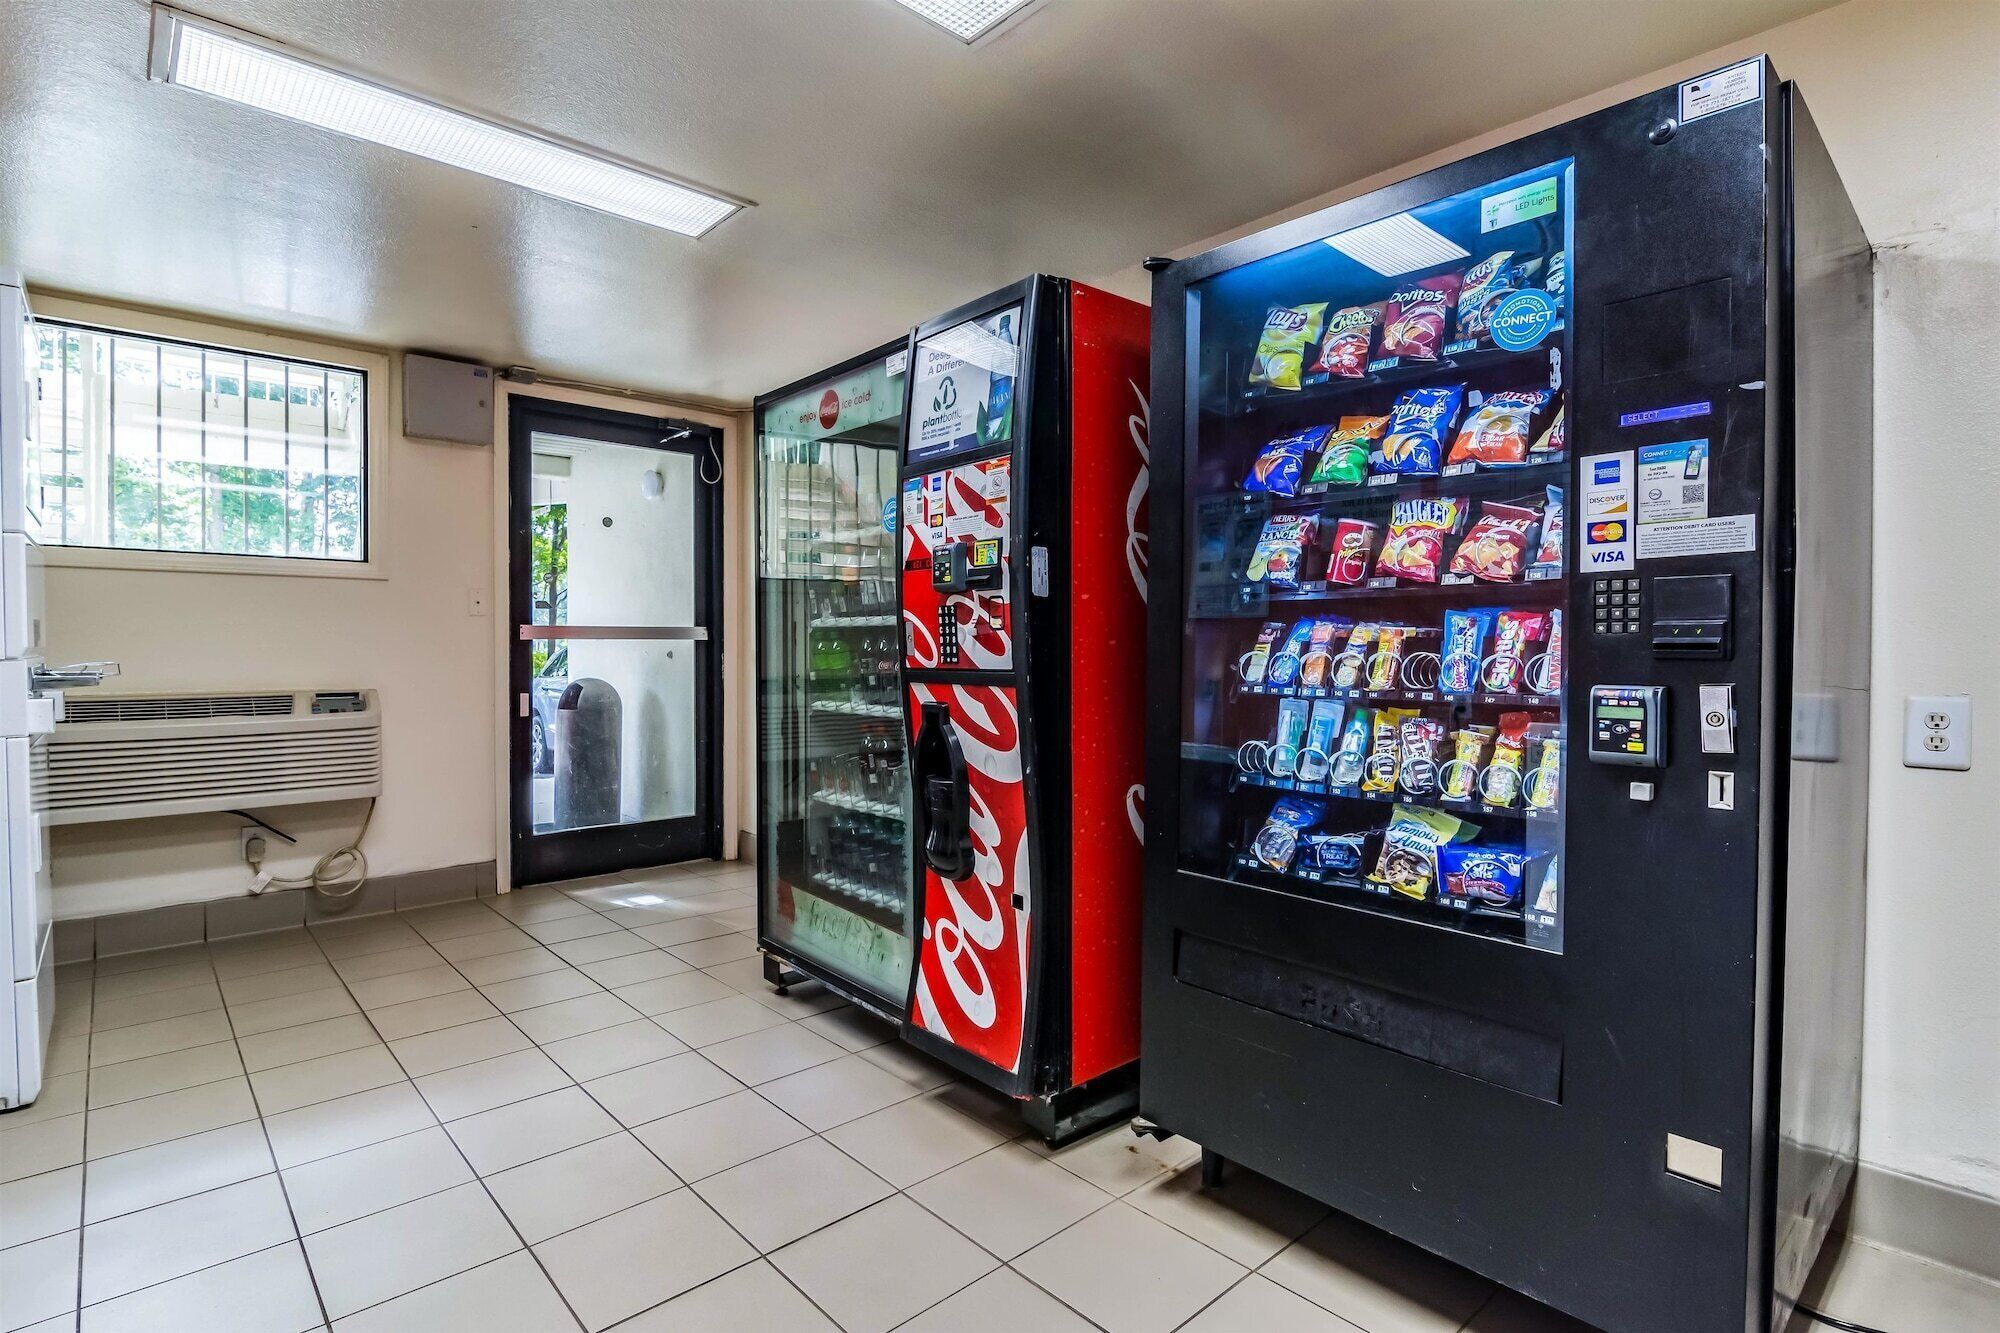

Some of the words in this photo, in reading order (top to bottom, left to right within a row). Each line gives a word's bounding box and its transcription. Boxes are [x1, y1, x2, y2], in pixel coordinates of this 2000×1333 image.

[1515, 201, 1530, 212] LED
[1532, 194, 1555, 206] Lights
[1389, 288, 1447, 304] Doritos
[1328, 309, 1381, 334] Cheetos
[1493, 310, 1553, 328] CONNECT
[927, 366, 934, 376] A
[935, 359, 967, 374] Differe
[799, 411, 817, 424] enjoy
[841, 398, 852, 409] ice
[853, 389, 872, 405] cold
[1627, 410, 1660, 424] SELECT
[1643, 449, 1674, 458] CONNECT
[1589, 494, 1626, 504] DISCOVER
[1653, 524, 1683, 532] ATTENTION
[1683, 522, 1700, 530] DEBIT
[1700, 521, 1717, 529] CARD
[1717, 520, 1736, 528] USERS
[932, 531, 944, 540] VISA
[1259, 529, 1300, 541] RANCH
[1591, 550, 1626, 564] VISA
[1387, 819, 1440, 843] Famous
[1390, 836, 1434, 856] Amos
[1321, 853, 1348, 861] TREATS
